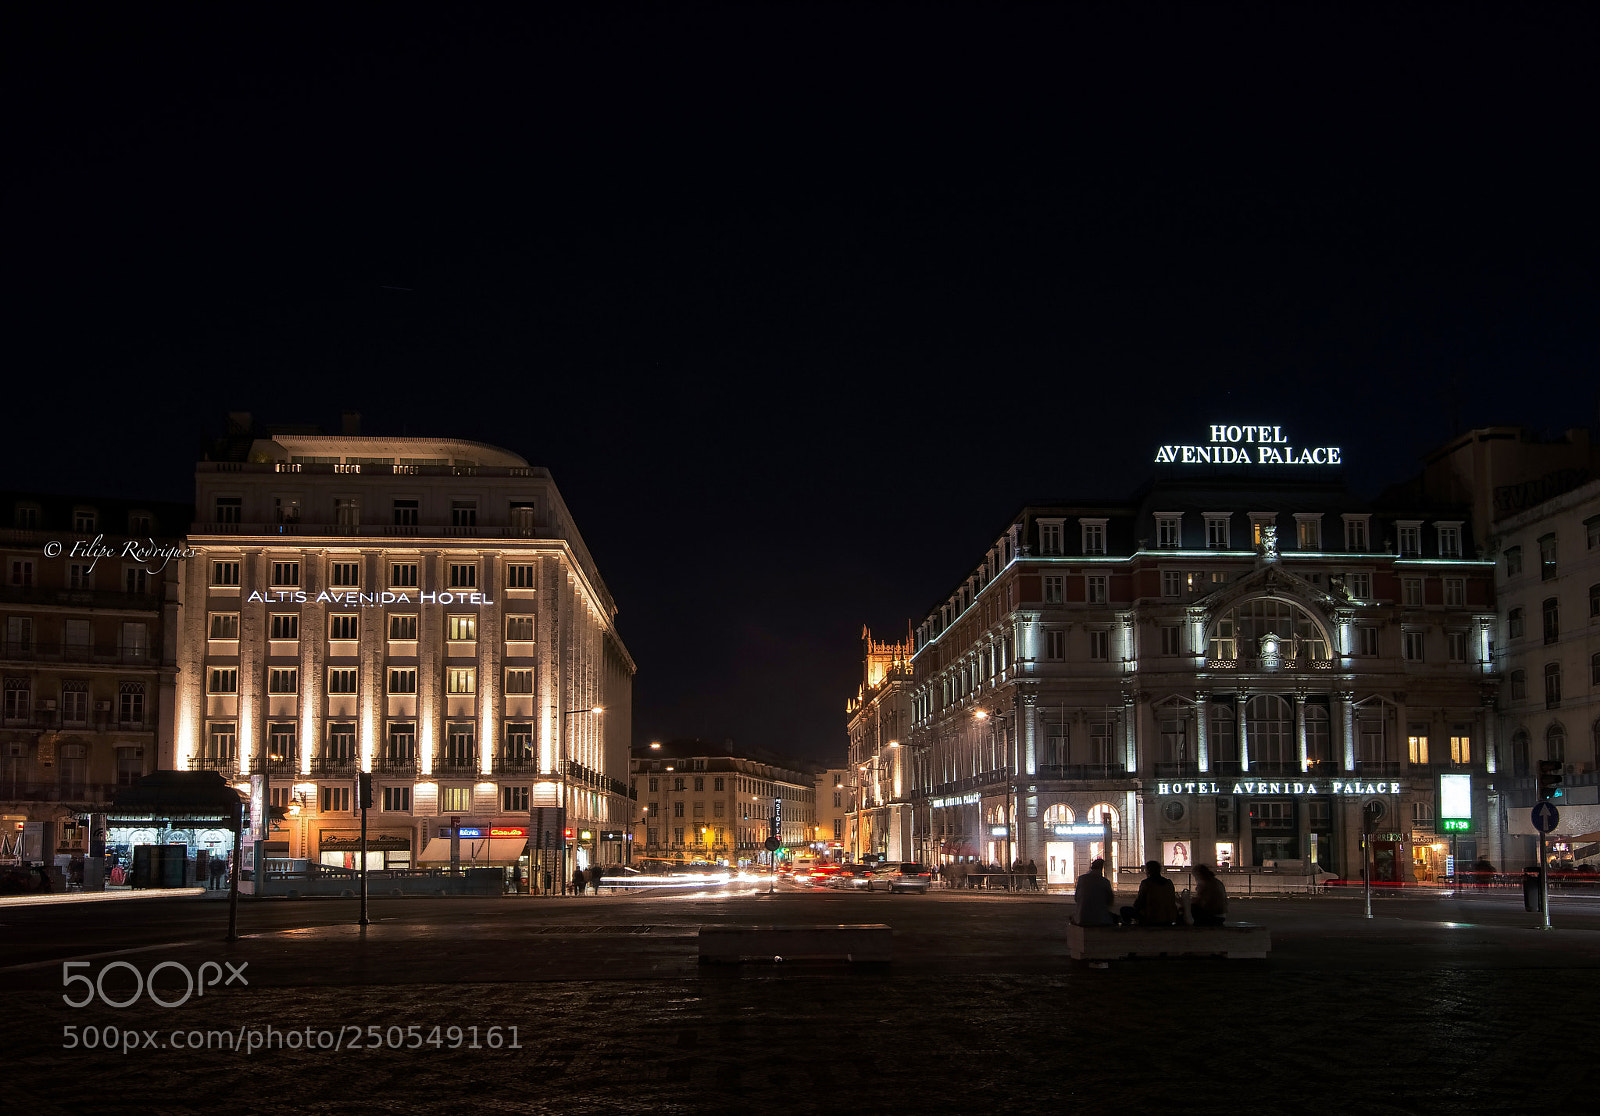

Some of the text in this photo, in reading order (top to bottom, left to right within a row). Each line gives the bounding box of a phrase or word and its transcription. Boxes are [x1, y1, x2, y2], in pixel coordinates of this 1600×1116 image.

[1210, 425, 1287, 443] HOTEL
[1155, 446, 1341, 464] AVENIDA PALACE
[247, 590, 494, 605] ALTIS AVENIDA HOTEL
[1157, 781, 1400, 795] HOTEL AVENIDA PALACE
